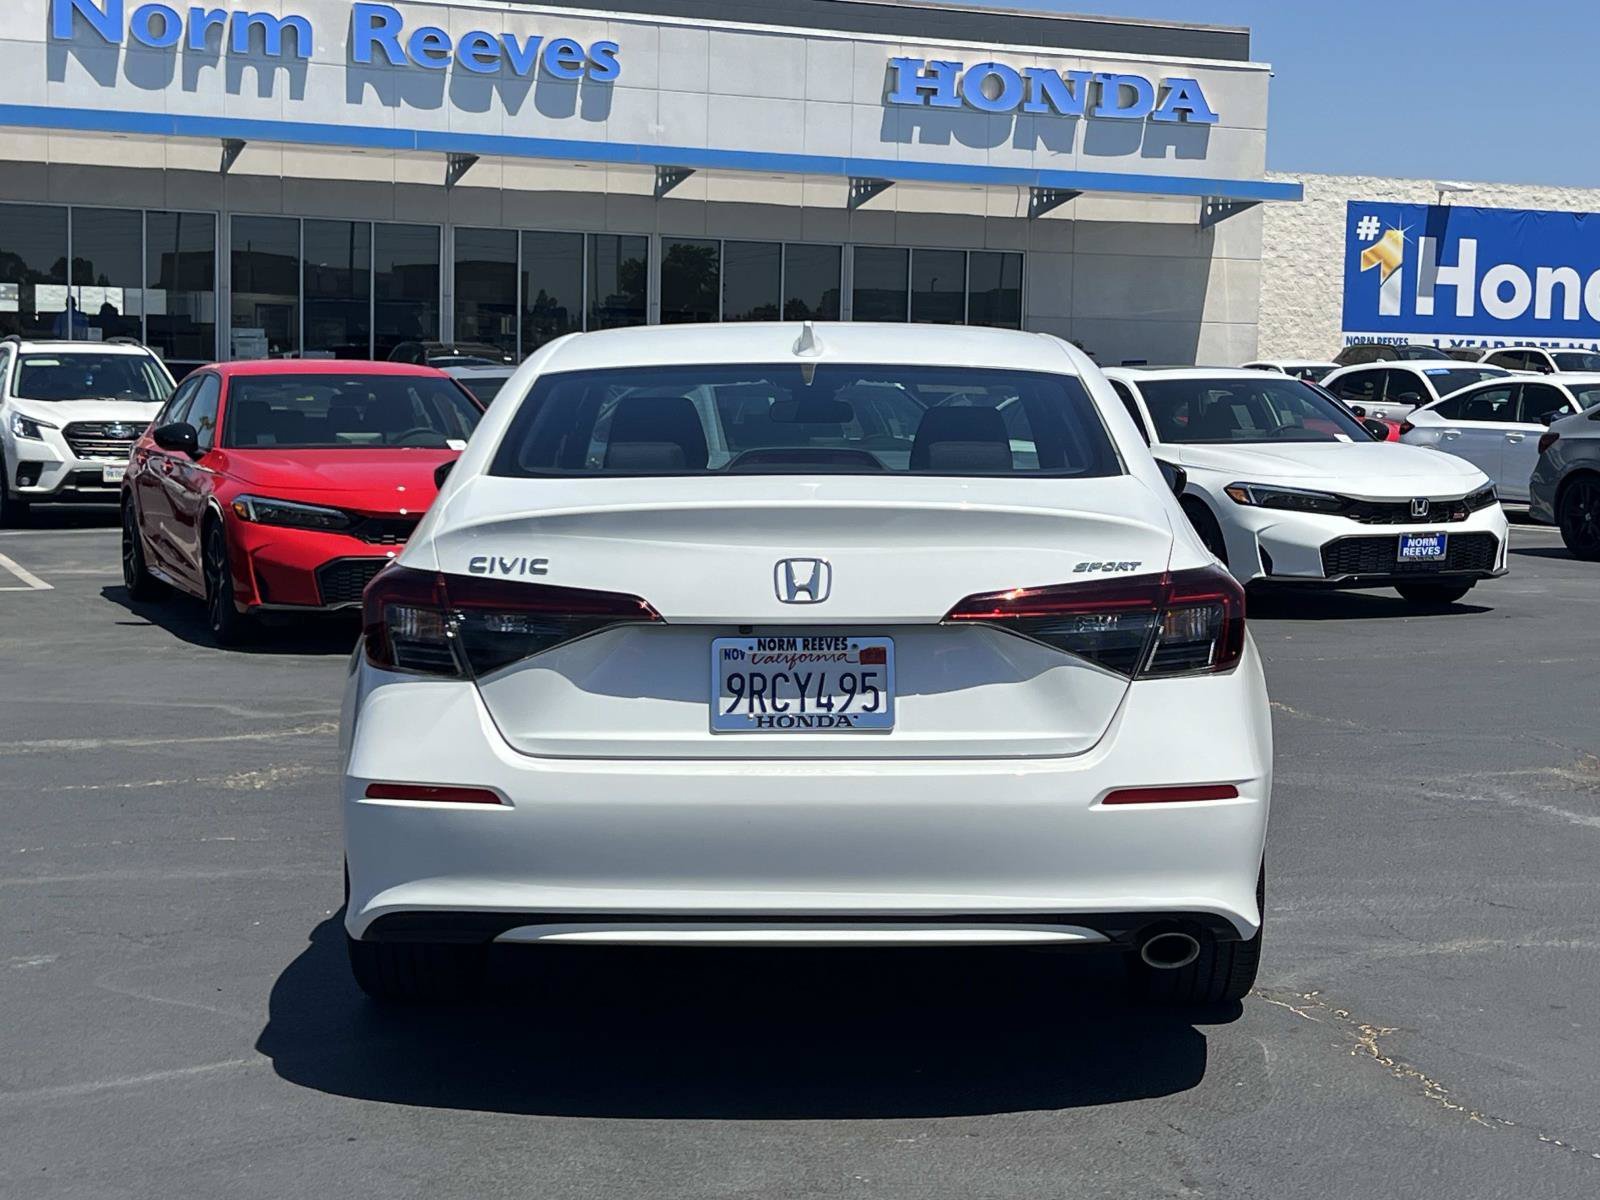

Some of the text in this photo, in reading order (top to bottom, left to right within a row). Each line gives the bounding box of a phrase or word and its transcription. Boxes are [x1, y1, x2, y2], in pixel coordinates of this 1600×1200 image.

[52, 0, 622, 83] Norm Reeves
[884, 57, 1219, 124] HONDA
[1407, 538, 1438, 547] NORM
[1402, 546, 1440, 556] REEVES
[468, 556, 549, 576] CIVIC
[1073, 561, 1142, 573] SPORT
[757, 637, 848, 651] NORM REEVES
[724, 649, 745, 661] NOV
[751, 651, 859, 671] California
[726, 672, 880, 713] 9RCY495
[756, 714, 854, 728] HONDA
